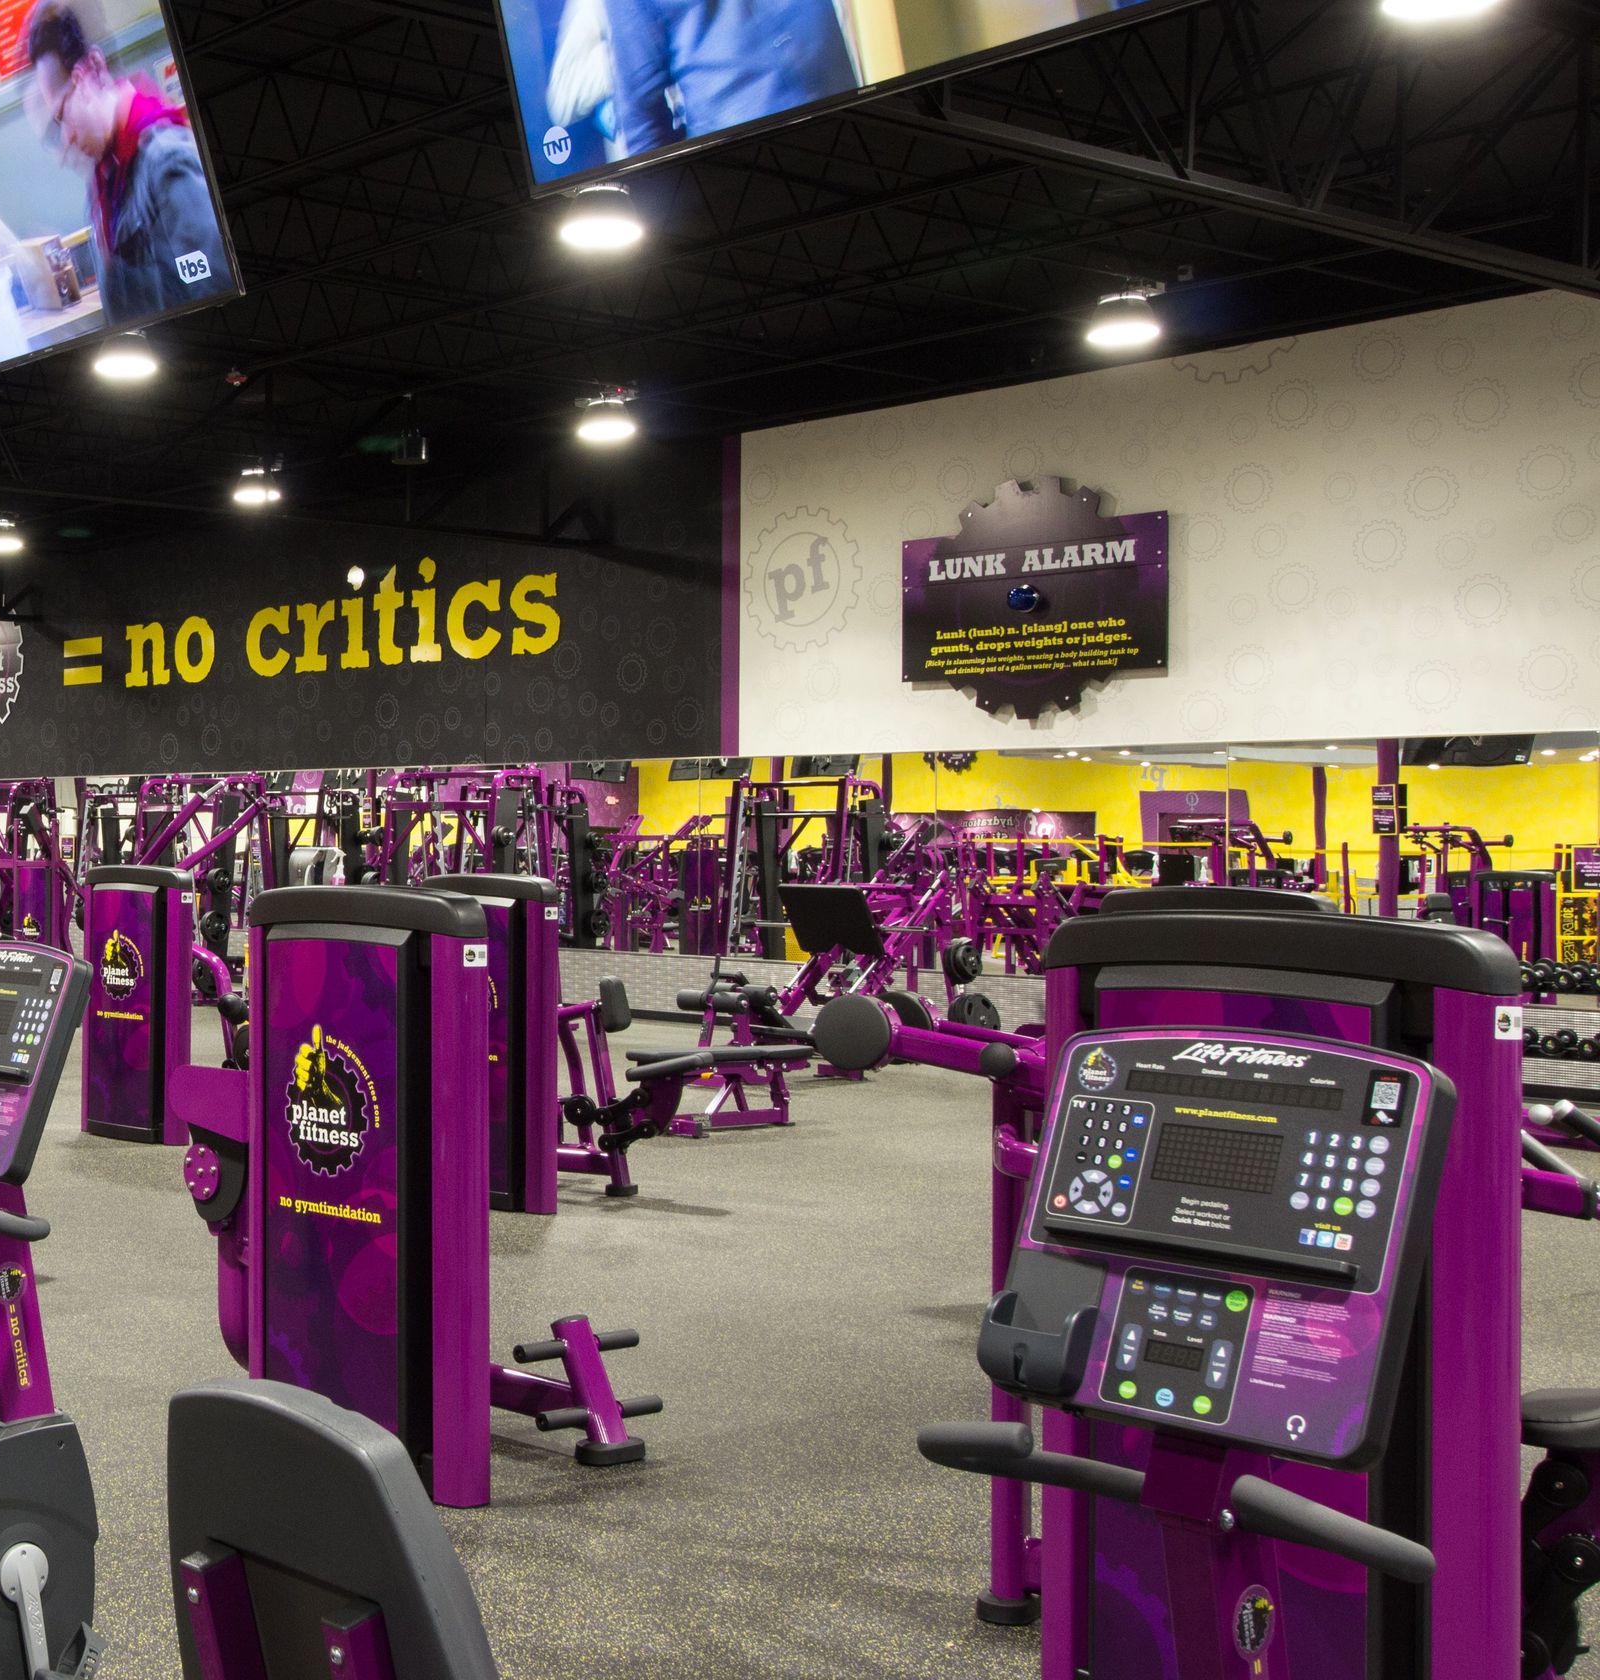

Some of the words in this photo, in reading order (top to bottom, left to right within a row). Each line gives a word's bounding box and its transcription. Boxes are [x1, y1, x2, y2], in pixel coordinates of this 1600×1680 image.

[543, 136, 570, 156] TNT
[179, 257, 208, 279] tbs
[928, 553, 1007, 582] LUNK
[1021, 539, 1137, 572] ALARM
[768, 536, 830, 623] pf
[125, 615, 216, 688] no
[246, 556, 561, 677] critics
[936, 629, 966, 640] Lunk
[967, 626, 1005, 639] (lunk)
[1007, 627, 1020, 635] n.
[1022, 621, 1068, 635] [slang]
[1070, 621, 1094, 630] one
[1097, 617, 1126, 628] who
[930, 644, 974, 656] grunts,
[975, 641, 1011, 652] drops
[1013, 637, 1063, 649] weights
[1066, 636, 1080, 645] or
[1081, 632, 1132, 646] judges.
[953, 657, 986, 666] slamming
[1026, 652, 1054, 661] wearing
[1060, 650, 1077, 659] body
[1079, 649, 1109, 657] building
[1127, 647, 1139, 655] top
[957, 666, 985, 674] drinking
[997, 664, 1005, 672] of
[1010, 663, 1031, 672] gallon
[1033, 662, 1051, 670] water
[1072, 659, 1090, 667] what
[103, 965, 129, 977] planet
[106, 975, 135, 986] fitness
[325, 1035, 337, 1046] the
[336, 1040, 370, 1081] judgement
[367, 1080, 378, 1102] free
[1082, 1068, 1108, 1077] planet
[1135, 1062, 1150, 1070] Heart
[1084, 1074, 1112, 1082] fitness
[1253, 1072, 1269, 1080] RPM
[1309, 1077, 1336, 1086] Calories
[291, 1100, 347, 1125] planet
[1072, 1099, 1087, 1108] TV
[1106, 1103, 1114, 1113] 2
[1123, 1105, 1131, 1115] 3
[1174, 1106, 1278, 1124] www.planetfitness.com
[1085, 1118, 1093, 1128] 4
[1102, 1120, 1110, 1130] 5
[1119, 1122, 1127, 1132] 6
[299, 1121, 360, 1148] fitness
[1098, 1137, 1106, 1148] 8
[1115, 1139, 1123, 1149] 9
[1309, 1131, 1317, 1145] 1
[1329, 1133, 1340, 1147] 2
[1351, 1135, 1362, 1149] 3
[1303, 1152, 1313, 1165] 4
[1325, 1154, 1335, 1168] 5
[1346, 1157, 1358, 1171] 6
[1300, 1173, 1309, 1186] 7
[1320, 1175, 1331, 1189] 8
[1342, 1178, 1353, 1192] 9
[1180, 1196, 1200, 1206] Begin
[1316, 1196, 1326, 1210] 0
[279, 1196, 292, 1207] no
[294, 1199, 381, 1224] gymtimidation
[1175, 1207, 1196, 1216] Select
[1171, 1215, 1192, 1225] Quick
[1193, 1218, 1210, 1227] Start
[1313, 1222, 1331, 1230] visit
[10, 1316, 20, 1336] no
[1153, 1329, 1167, 1337] Time
[1187, 1335, 1203, 1344] Level
[14, 1339, 29, 1387] critics
